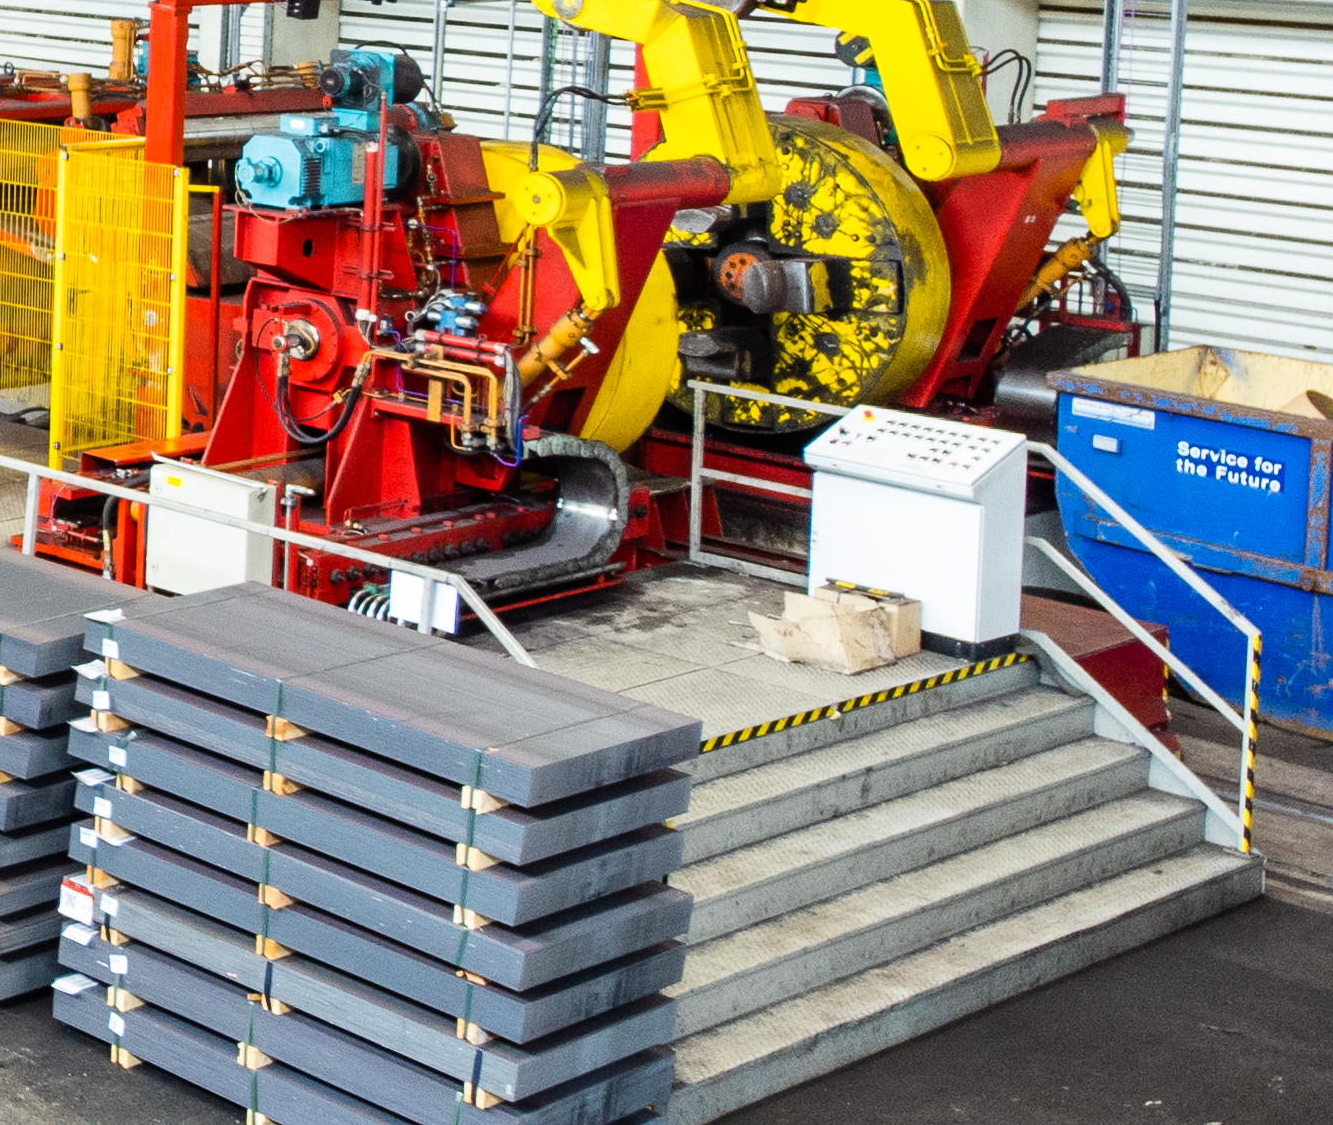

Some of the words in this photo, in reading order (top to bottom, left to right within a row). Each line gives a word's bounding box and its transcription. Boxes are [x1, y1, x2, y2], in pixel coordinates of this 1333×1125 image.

[1176, 458, 1208, 478] the
[1215, 465, 1282, 494] Future
[1177, 440, 1249, 469] Service
[1254, 456, 1282, 476] for
